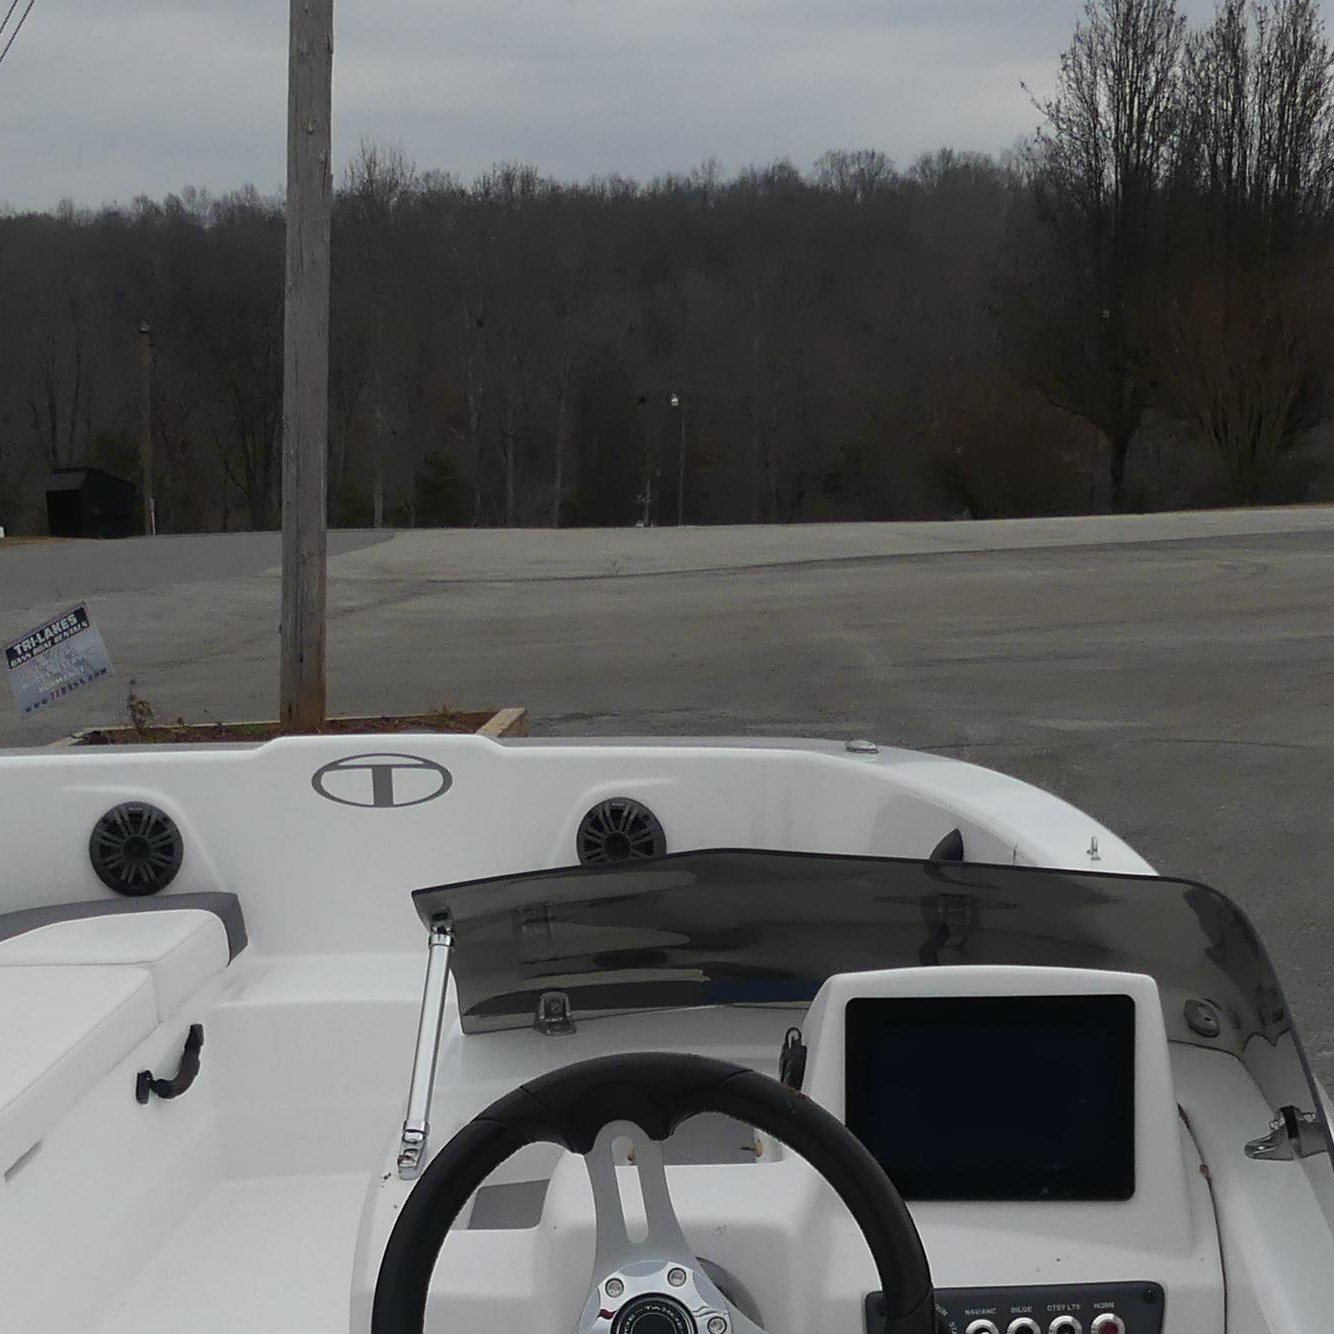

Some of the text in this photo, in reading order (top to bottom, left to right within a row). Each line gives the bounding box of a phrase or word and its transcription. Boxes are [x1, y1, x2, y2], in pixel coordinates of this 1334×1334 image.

[14, 613, 78, 655] TRI-LAKES
[1011, 1305, 1033, 1314] BILGE
[1067, 1303, 1081, 1312] LTS
[1093, 1302, 1115, 1310] HORN
